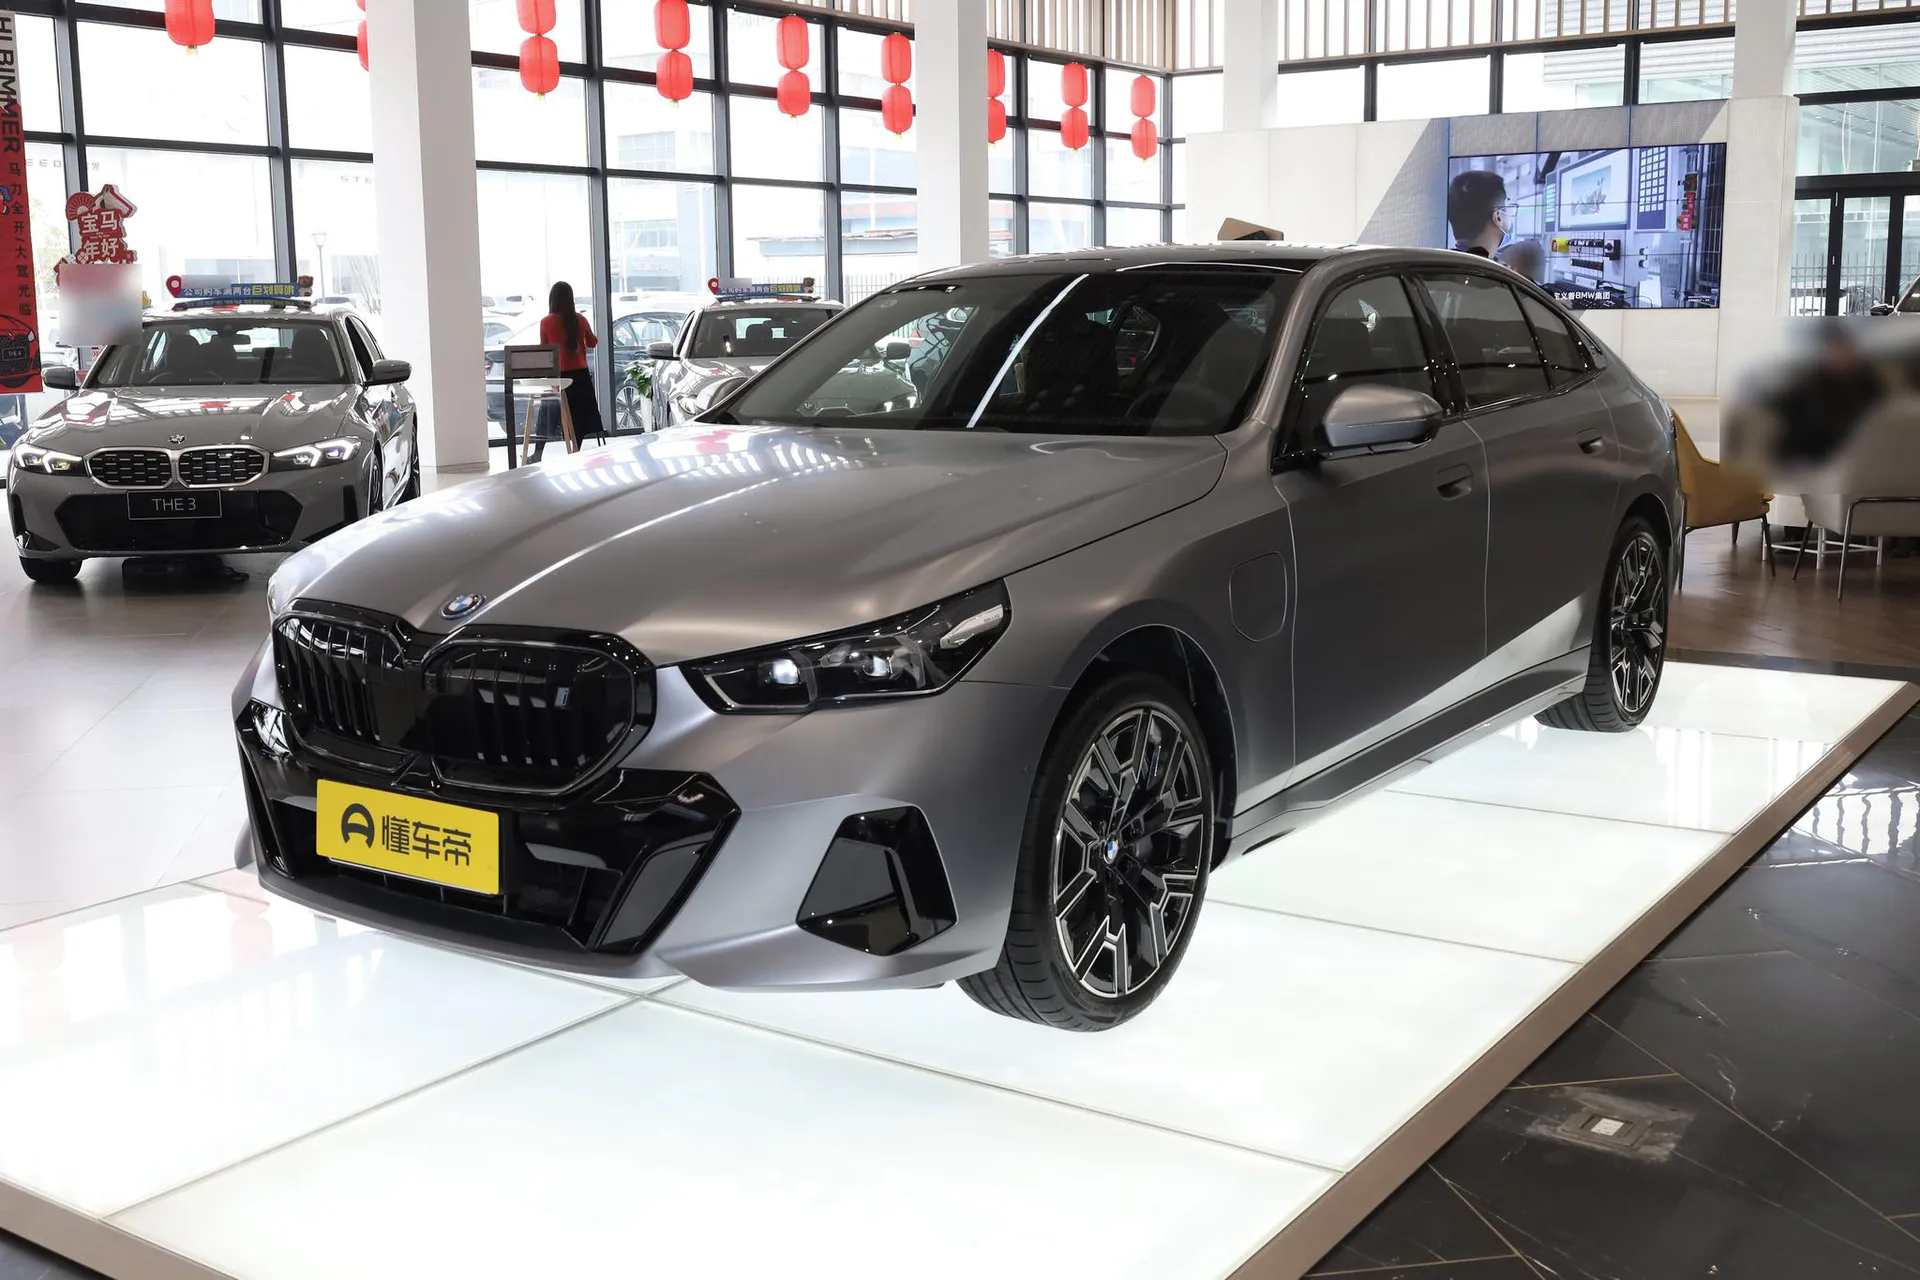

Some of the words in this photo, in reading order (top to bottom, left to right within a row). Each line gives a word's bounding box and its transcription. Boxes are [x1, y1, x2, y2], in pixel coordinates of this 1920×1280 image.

[0, 17, 12, 41] HI
[0, 49, 20, 153] BIMMER
[81, 211, 117, 233] 宝马
[84, 238, 119, 259] 年好
[151, 498, 184, 511] THE
[187, 497, 196, 511] 3
[381, 815, 472, 866] 懂车帝
